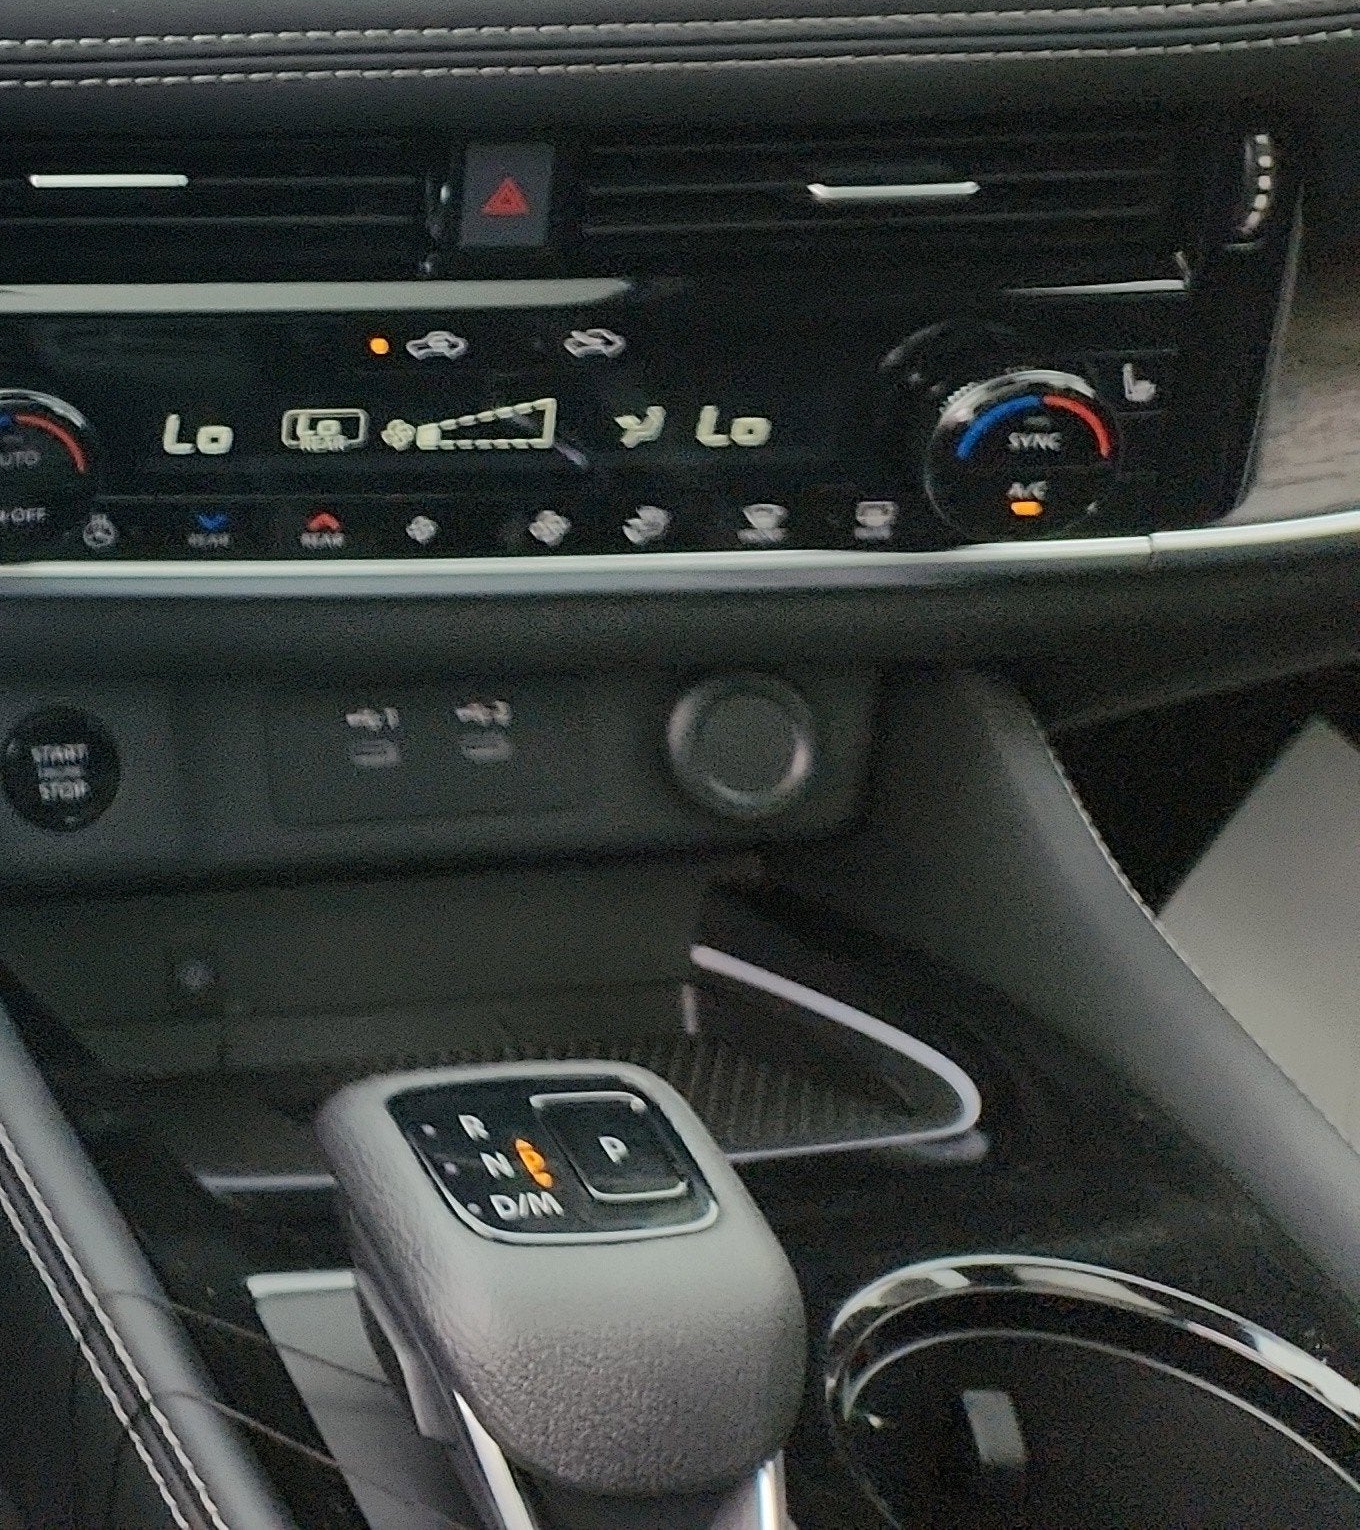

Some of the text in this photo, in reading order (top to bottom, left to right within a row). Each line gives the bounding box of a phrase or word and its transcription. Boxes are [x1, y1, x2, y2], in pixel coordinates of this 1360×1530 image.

[1008, 432, 1061, 451] SYNC
[458, 1114, 490, 1141] R
[598, 1136, 628, 1164] P
[481, 1151, 516, 1180] N
